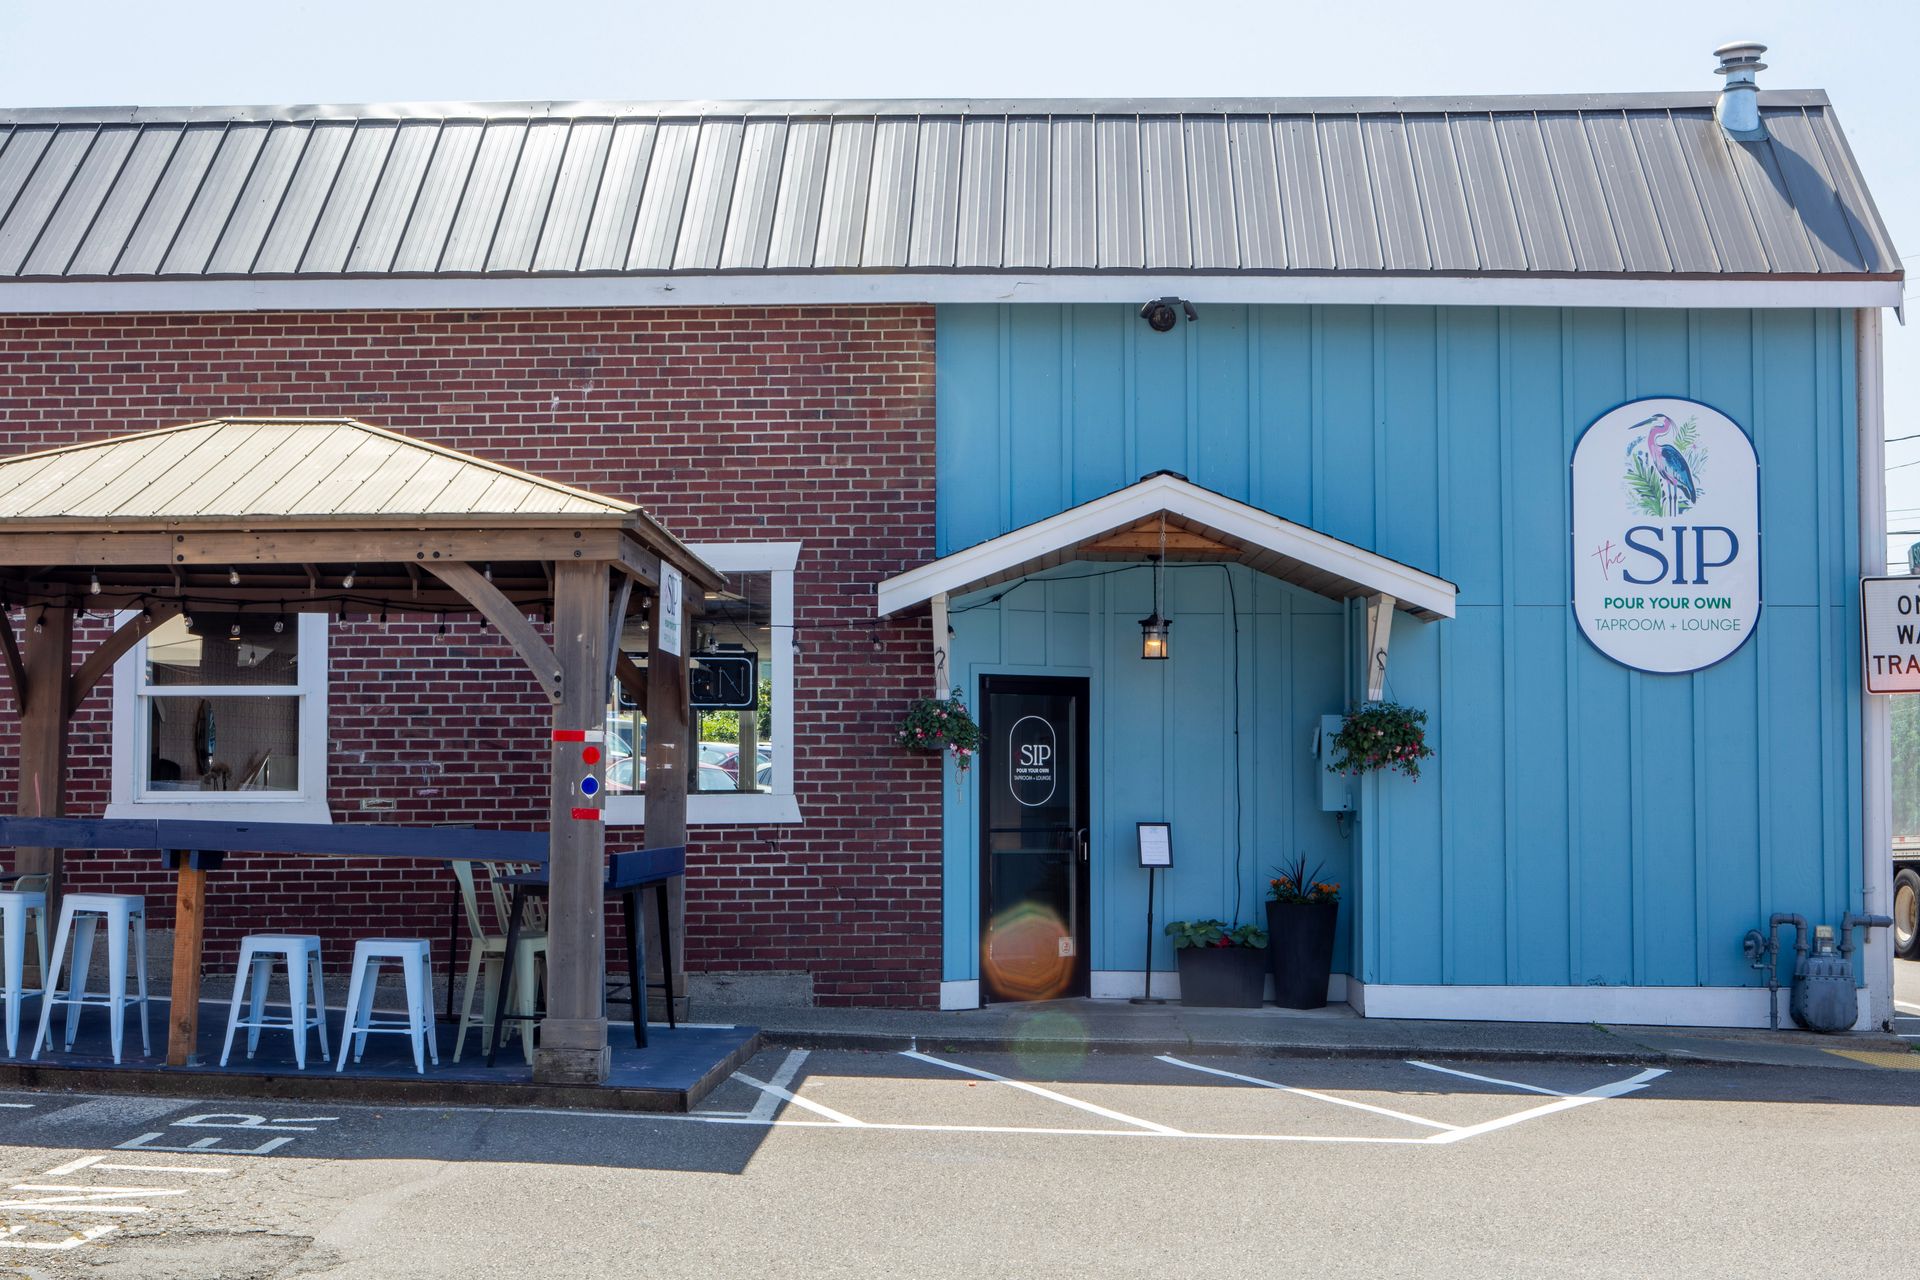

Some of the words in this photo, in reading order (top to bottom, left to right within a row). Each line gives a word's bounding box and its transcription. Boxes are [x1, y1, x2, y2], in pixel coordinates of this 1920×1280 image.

[1592, 540, 1626, 580] the
[1622, 525, 1740, 585] SIP
[1604, 597, 1645, 609] POUR
[1649, 597, 1690, 609] YOUR
[1694, 597, 1732, 609] OWN
[1595, 618, 1666, 631] TAPROOM
[1681, 618, 1741, 631] LOUNGE
[1897, 624, 1920, 645] W
[1020, 744, 1051, 765] SIP
